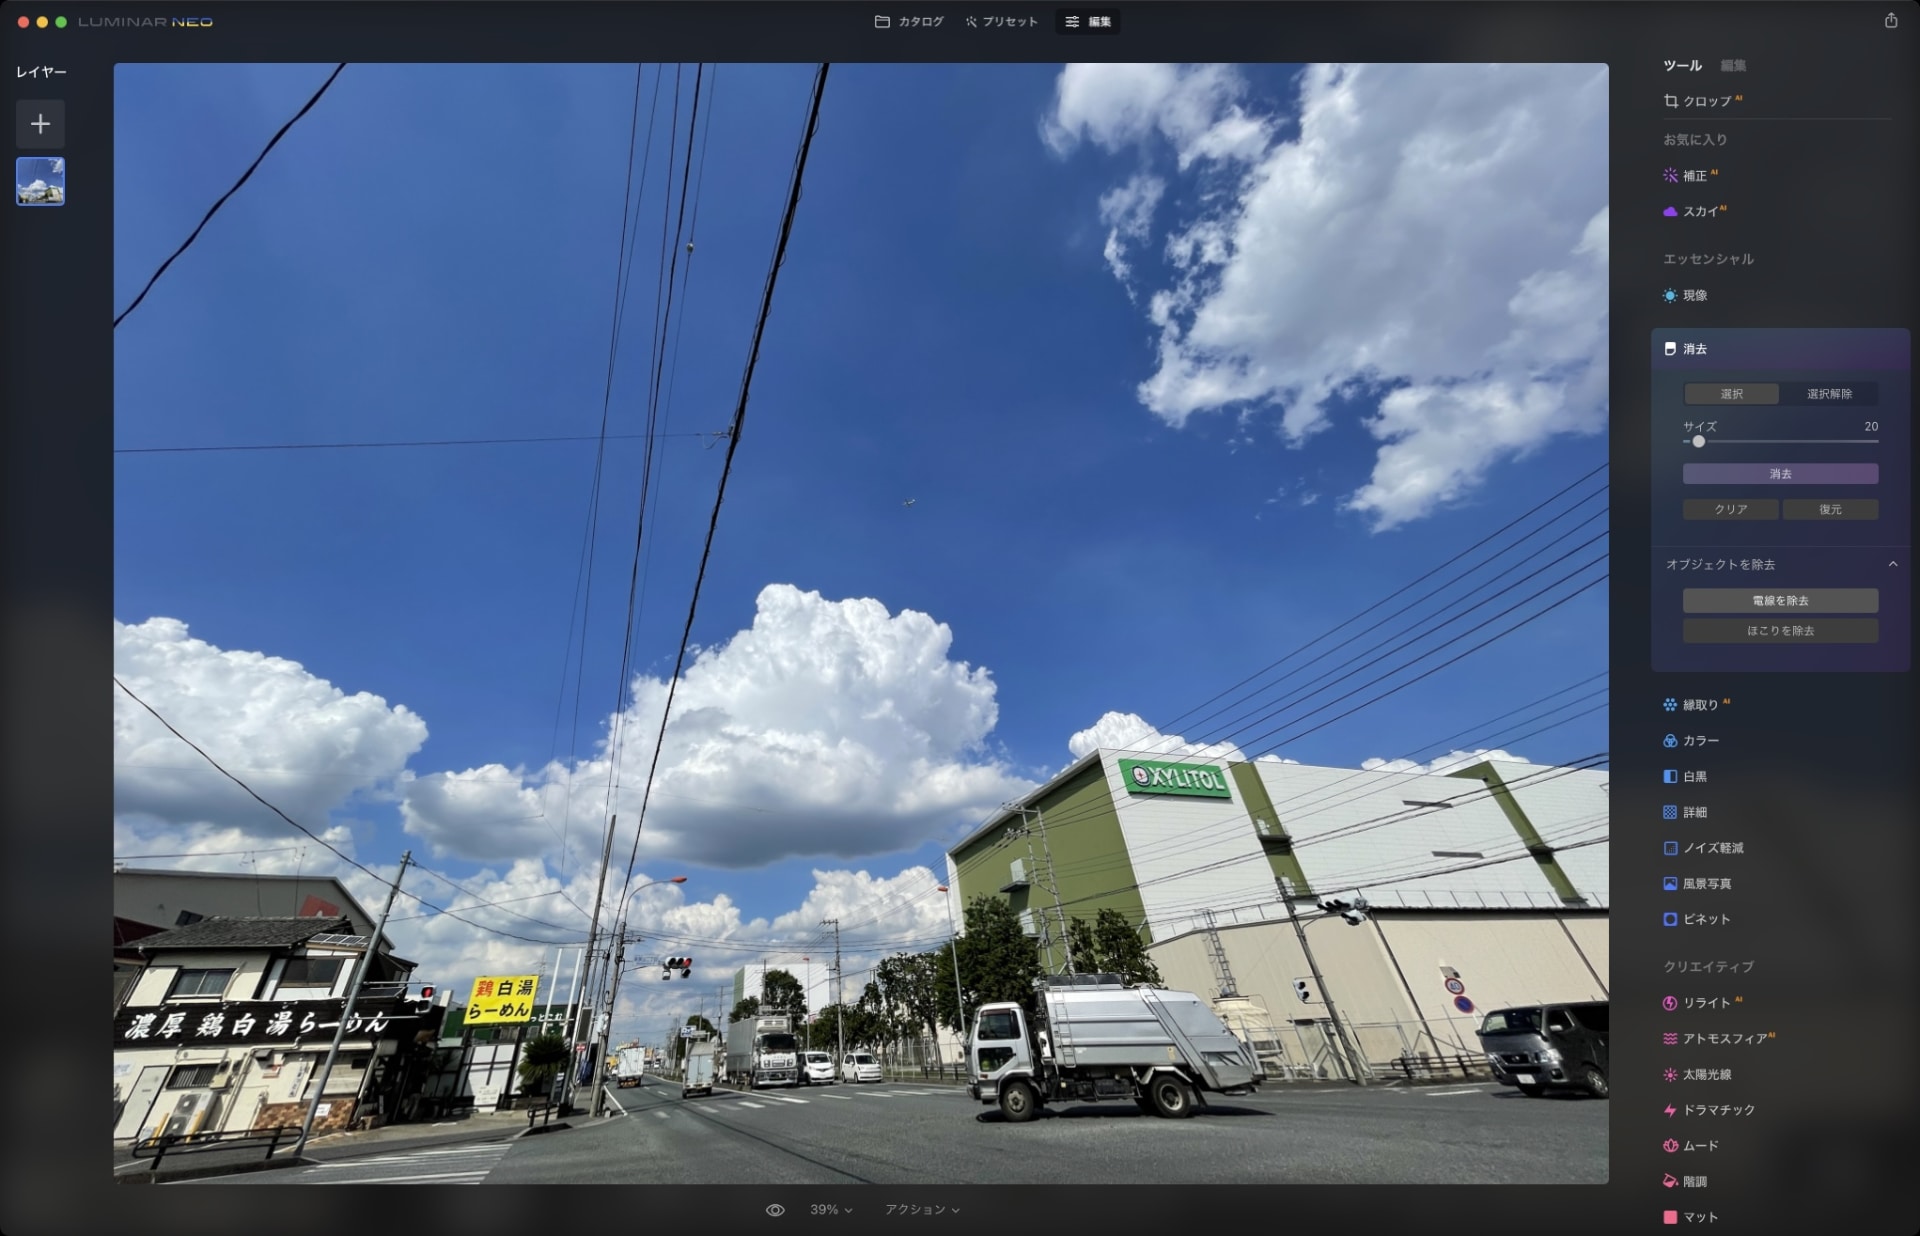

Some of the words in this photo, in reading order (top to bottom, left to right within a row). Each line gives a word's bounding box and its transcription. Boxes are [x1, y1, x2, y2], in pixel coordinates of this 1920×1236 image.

[78, 17, 168, 27] LUMINAR
[172, 17, 213, 27] NEO
[899, 15, 945, 28] カタログ
[983, 15, 1038, 28] プリセット
[1088, 15, 1112, 28] 編集
[1663, 59, 1703, 72] ツール
[1720, 58, 1747, 72] 編集
[17, 65, 67, 79] レイヤー
[1684, 95, 1732, 108] クロップ
[1663, 132, 1727, 147] お気に入り
[1683, 169, 1708, 183] 補正
[1710, 168, 1719, 176] AI
[1683, 205, 1719, 218] スカイ
[1719, 204, 1728, 212] AI
[1663, 253, 1755, 266] エッセンシャル
[1683, 289, 1708, 302] 現像
[1683, 342, 1708, 355] 消去
[1720, 388, 1743, 400] 選択
[1807, 388, 1853, 400] 選択解除
[1683, 420, 1718, 433] サイズ
[1864, 421, 1879, 432] 20
[1769, 467, 1792, 480] 消去
[1715, 504, 1748, 515] クリア
[1819, 503, 1842, 516] 復元
[1666, 557, 1776, 571] オブジェクトを除去
[1752, 595, 1809, 607] 電線を除去
[1747, 625, 1815, 637] ほこりを除去
[1683, 698, 1718, 712] 縁取り
[1722, 697, 1731, 705] AI
[1683, 734, 1720, 747] カラー
[1148, 766, 1225, 791] XYLITOL
[1684, 770, 1708, 783] 白黒
[1683, 806, 1708, 819] 詳細
[1684, 841, 1745, 855] ノイズ軽減
[1683, 877, 1732, 890] 風景写真
[1684, 913, 1731, 926] ビネット
[1664, 959, 1755, 974] クリエイティブ
[475, 979, 534, 998] 鶏白湯
[1685, 997, 1731, 1009] リライト
[1734, 995, 1743, 1003] AI
[469, 1002, 530, 1019] らーめん
[1683, 1032, 1767, 1045] アトモスフィア
[1767, 1031, 1776, 1039] AI
[1683, 1068, 1732, 1081] 太陽光線
[1685, 1104, 1755, 1117] ドラマチック
[1683, 1139, 1719, 1152] ムード
[1683, 1175, 1708, 1188] 階調
[810, 1203, 839, 1215] 39%
[885, 1203, 946, 1216] アクション
[1683, 1211, 1718, 1224] マット
